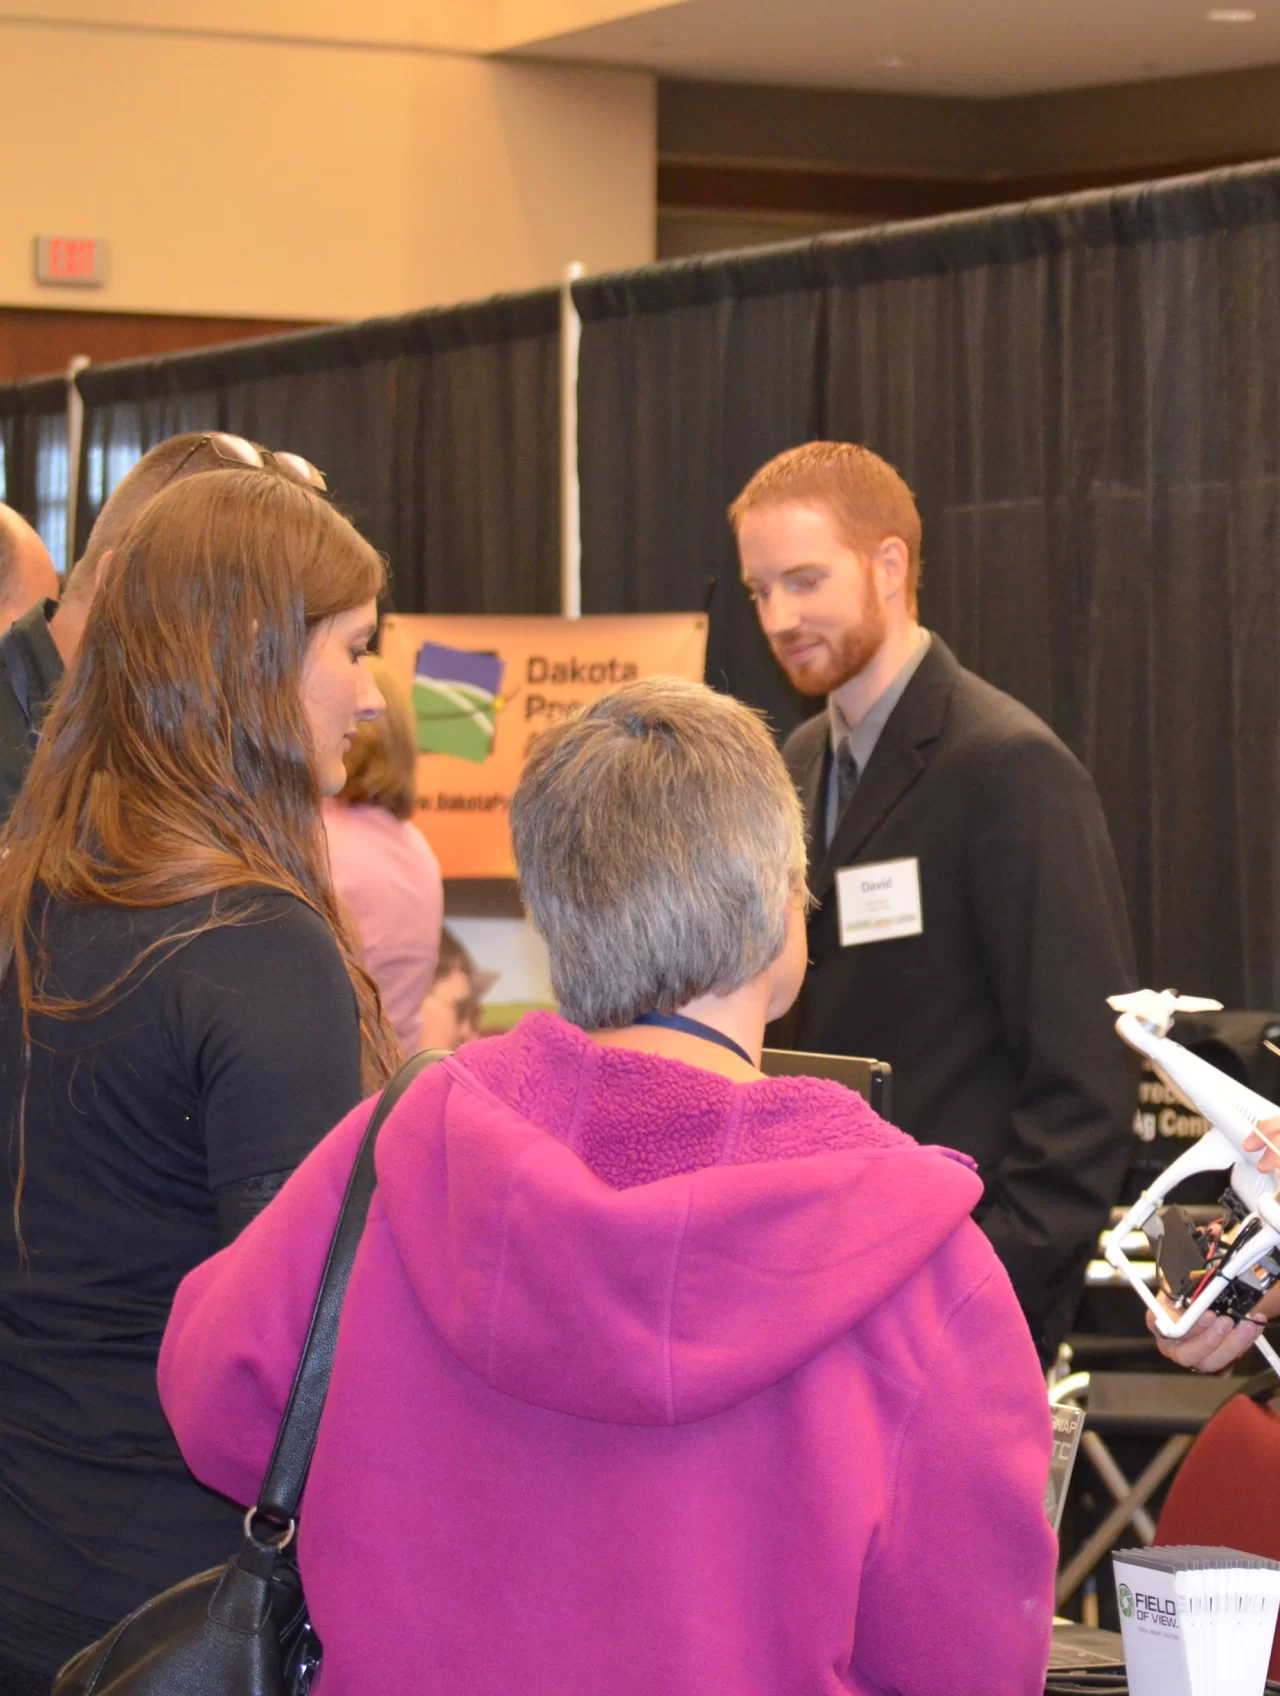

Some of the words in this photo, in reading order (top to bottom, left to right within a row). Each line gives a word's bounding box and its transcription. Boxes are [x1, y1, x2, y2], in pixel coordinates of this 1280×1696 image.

[51, 239, 95, 276] EXIT
[527, 655, 638, 685] Dakota
[861, 877, 892, 893] David
[1135, 1592, 1176, 1616] FIELD
[1136, 1610, 1150, 1622] OF
[1151, 1613, 1177, 1628] VIEW
